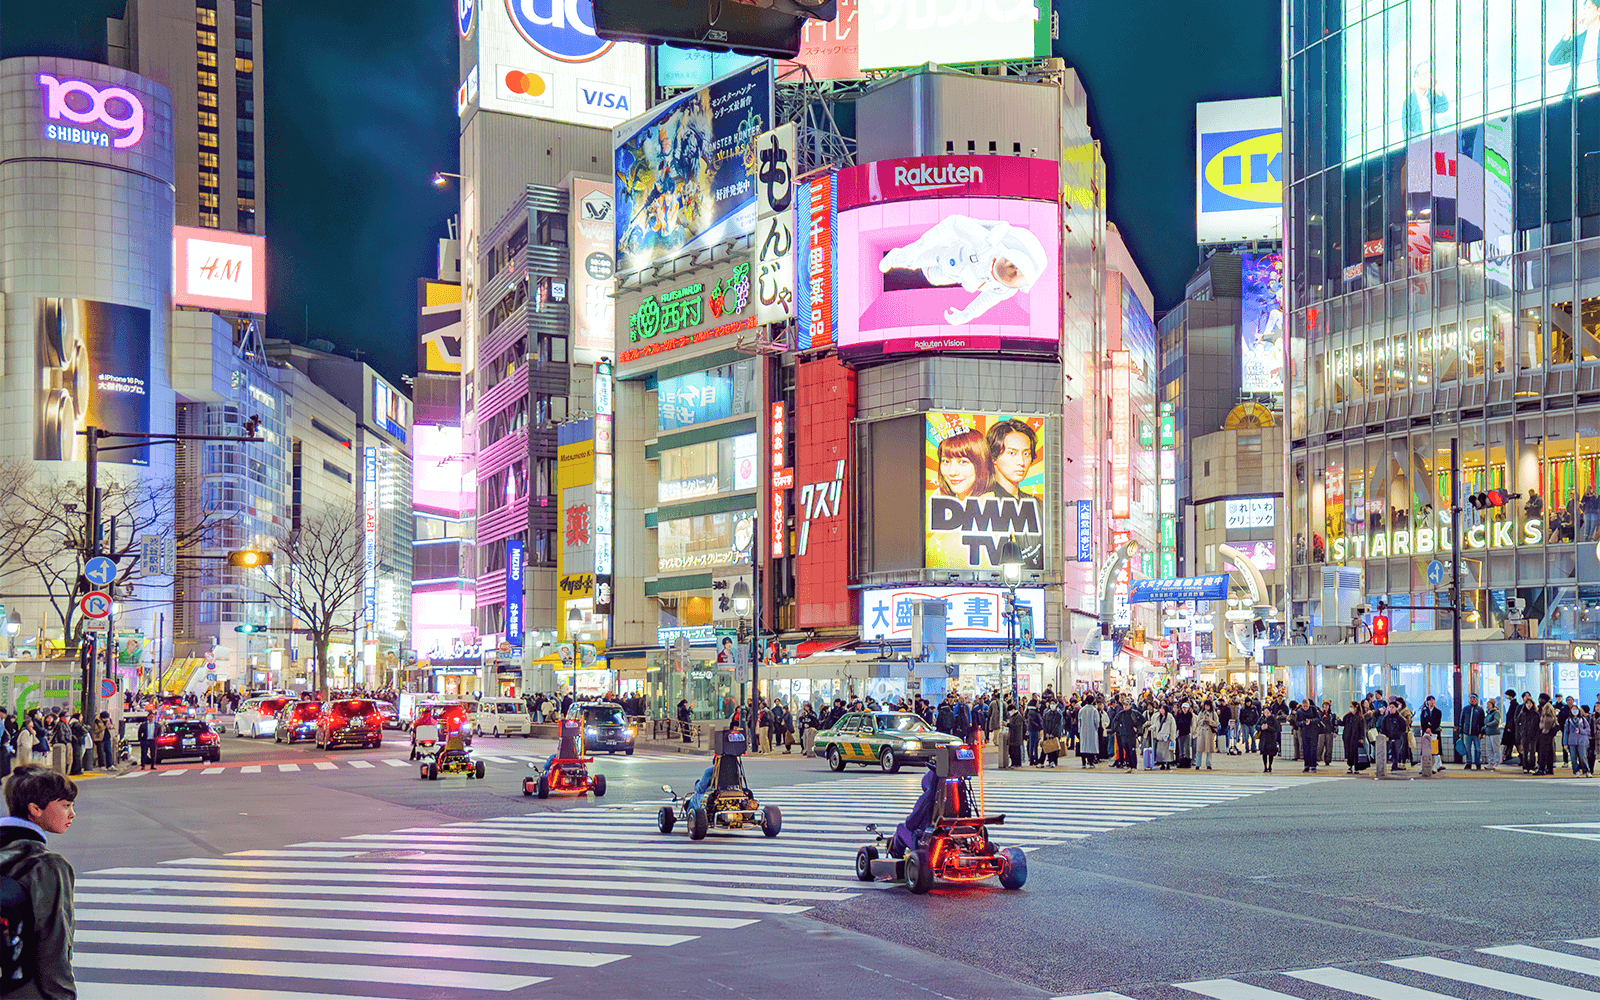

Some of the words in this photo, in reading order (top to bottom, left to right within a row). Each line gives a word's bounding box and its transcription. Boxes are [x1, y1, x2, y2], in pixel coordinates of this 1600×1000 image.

[507, 94, 545, 105] mastercard
[580, 87, 629, 111] VISA
[712, 83, 757, 107] モンスターハンター
[714, 96, 752, 119] シリーズ最新作
[38, 74, 145, 148] 109
[47, 124, 110, 147] SHIBUYA
[734, 124, 761, 143] HUNTER
[895, 163, 983, 186] Rakuten
[716, 179, 750, 201] 好評発売中
[759, 134, 792, 314] もんじゃ
[200, 257, 243, 283] H&M
[809, 183, 825, 337] 三千里薬品
[661, 295, 702, 334] 西村
[915, 340, 942, 349] Rakuten
[944, 339, 965, 347] Vision
[105, 374, 126, 382] iPhone
[367, 456, 376, 482] LABI
[560, 453, 585, 463] Matsumoto
[798, 460, 845, 556] クスリ
[931, 498, 1039, 532] DMM
[1239, 502, 1273, 513] れいわ
[566, 504, 591, 546] 薬
[1080, 503, 1090, 559] 大盛堂商事ビル
[1229, 515, 1273, 526] クリニック
[962, 535, 1009, 565] TV
[1334, 519, 1543, 560] STARBUCKS
[511, 548, 520, 580] MIZUHO
[365, 597, 374, 621] LABI
[510, 602, 519, 637] みずほ銀行
